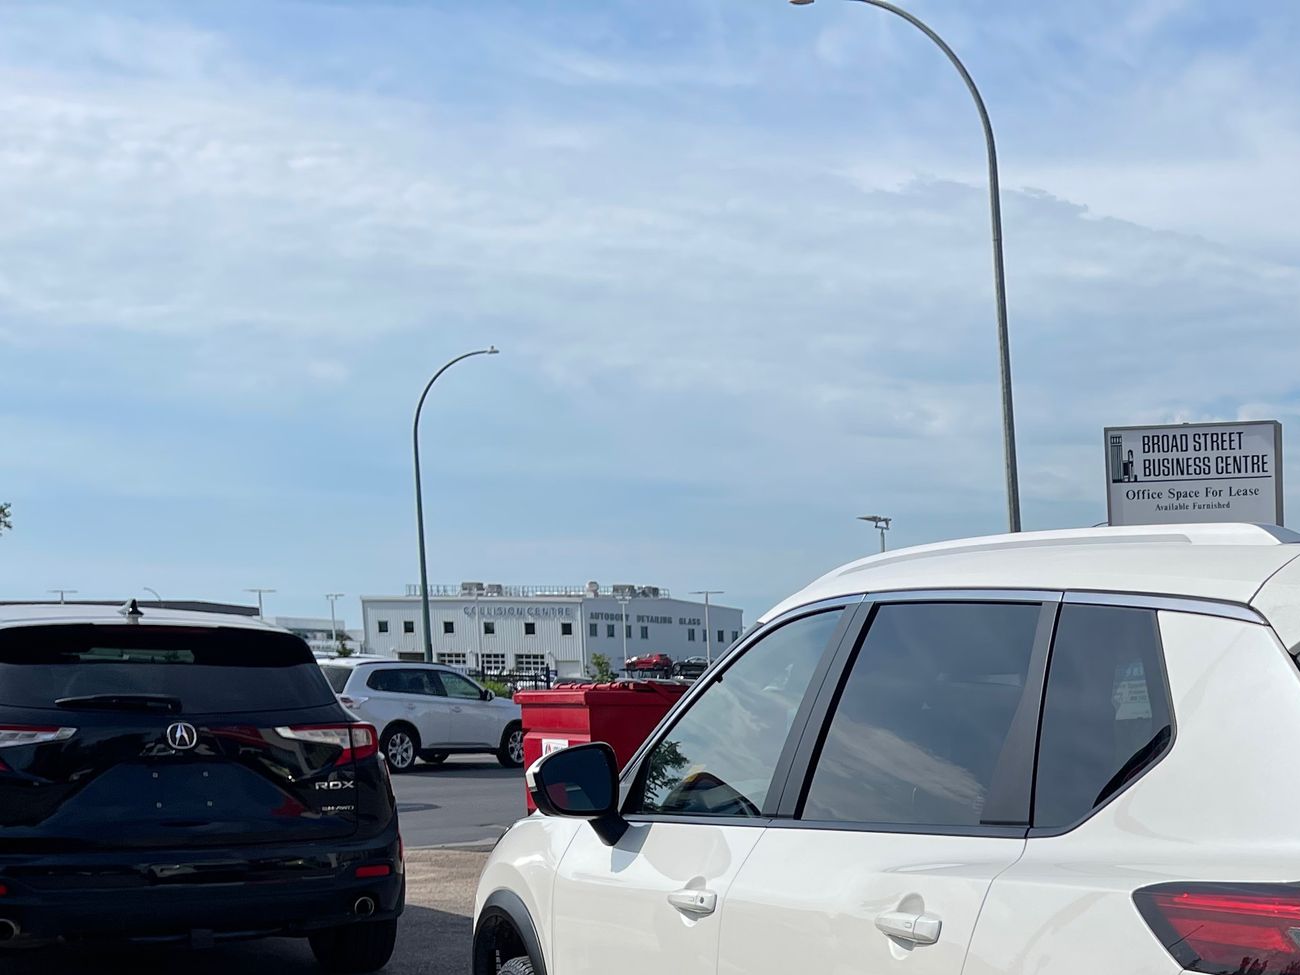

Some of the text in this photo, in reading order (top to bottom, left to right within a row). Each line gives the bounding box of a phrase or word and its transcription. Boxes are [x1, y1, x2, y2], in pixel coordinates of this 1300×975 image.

[1142, 431, 1244, 454] BROAD STREET
[1143, 454, 1269, 478] BUSINESS CENTRE
[1125, 486, 1260, 501] Office Space For Lease
[1155, 501, 1231, 511] Available Furnished
[526, 606, 572, 617] CENTRE
[678, 617, 701, 626] GLASS
[315, 780, 354, 790] RDX
